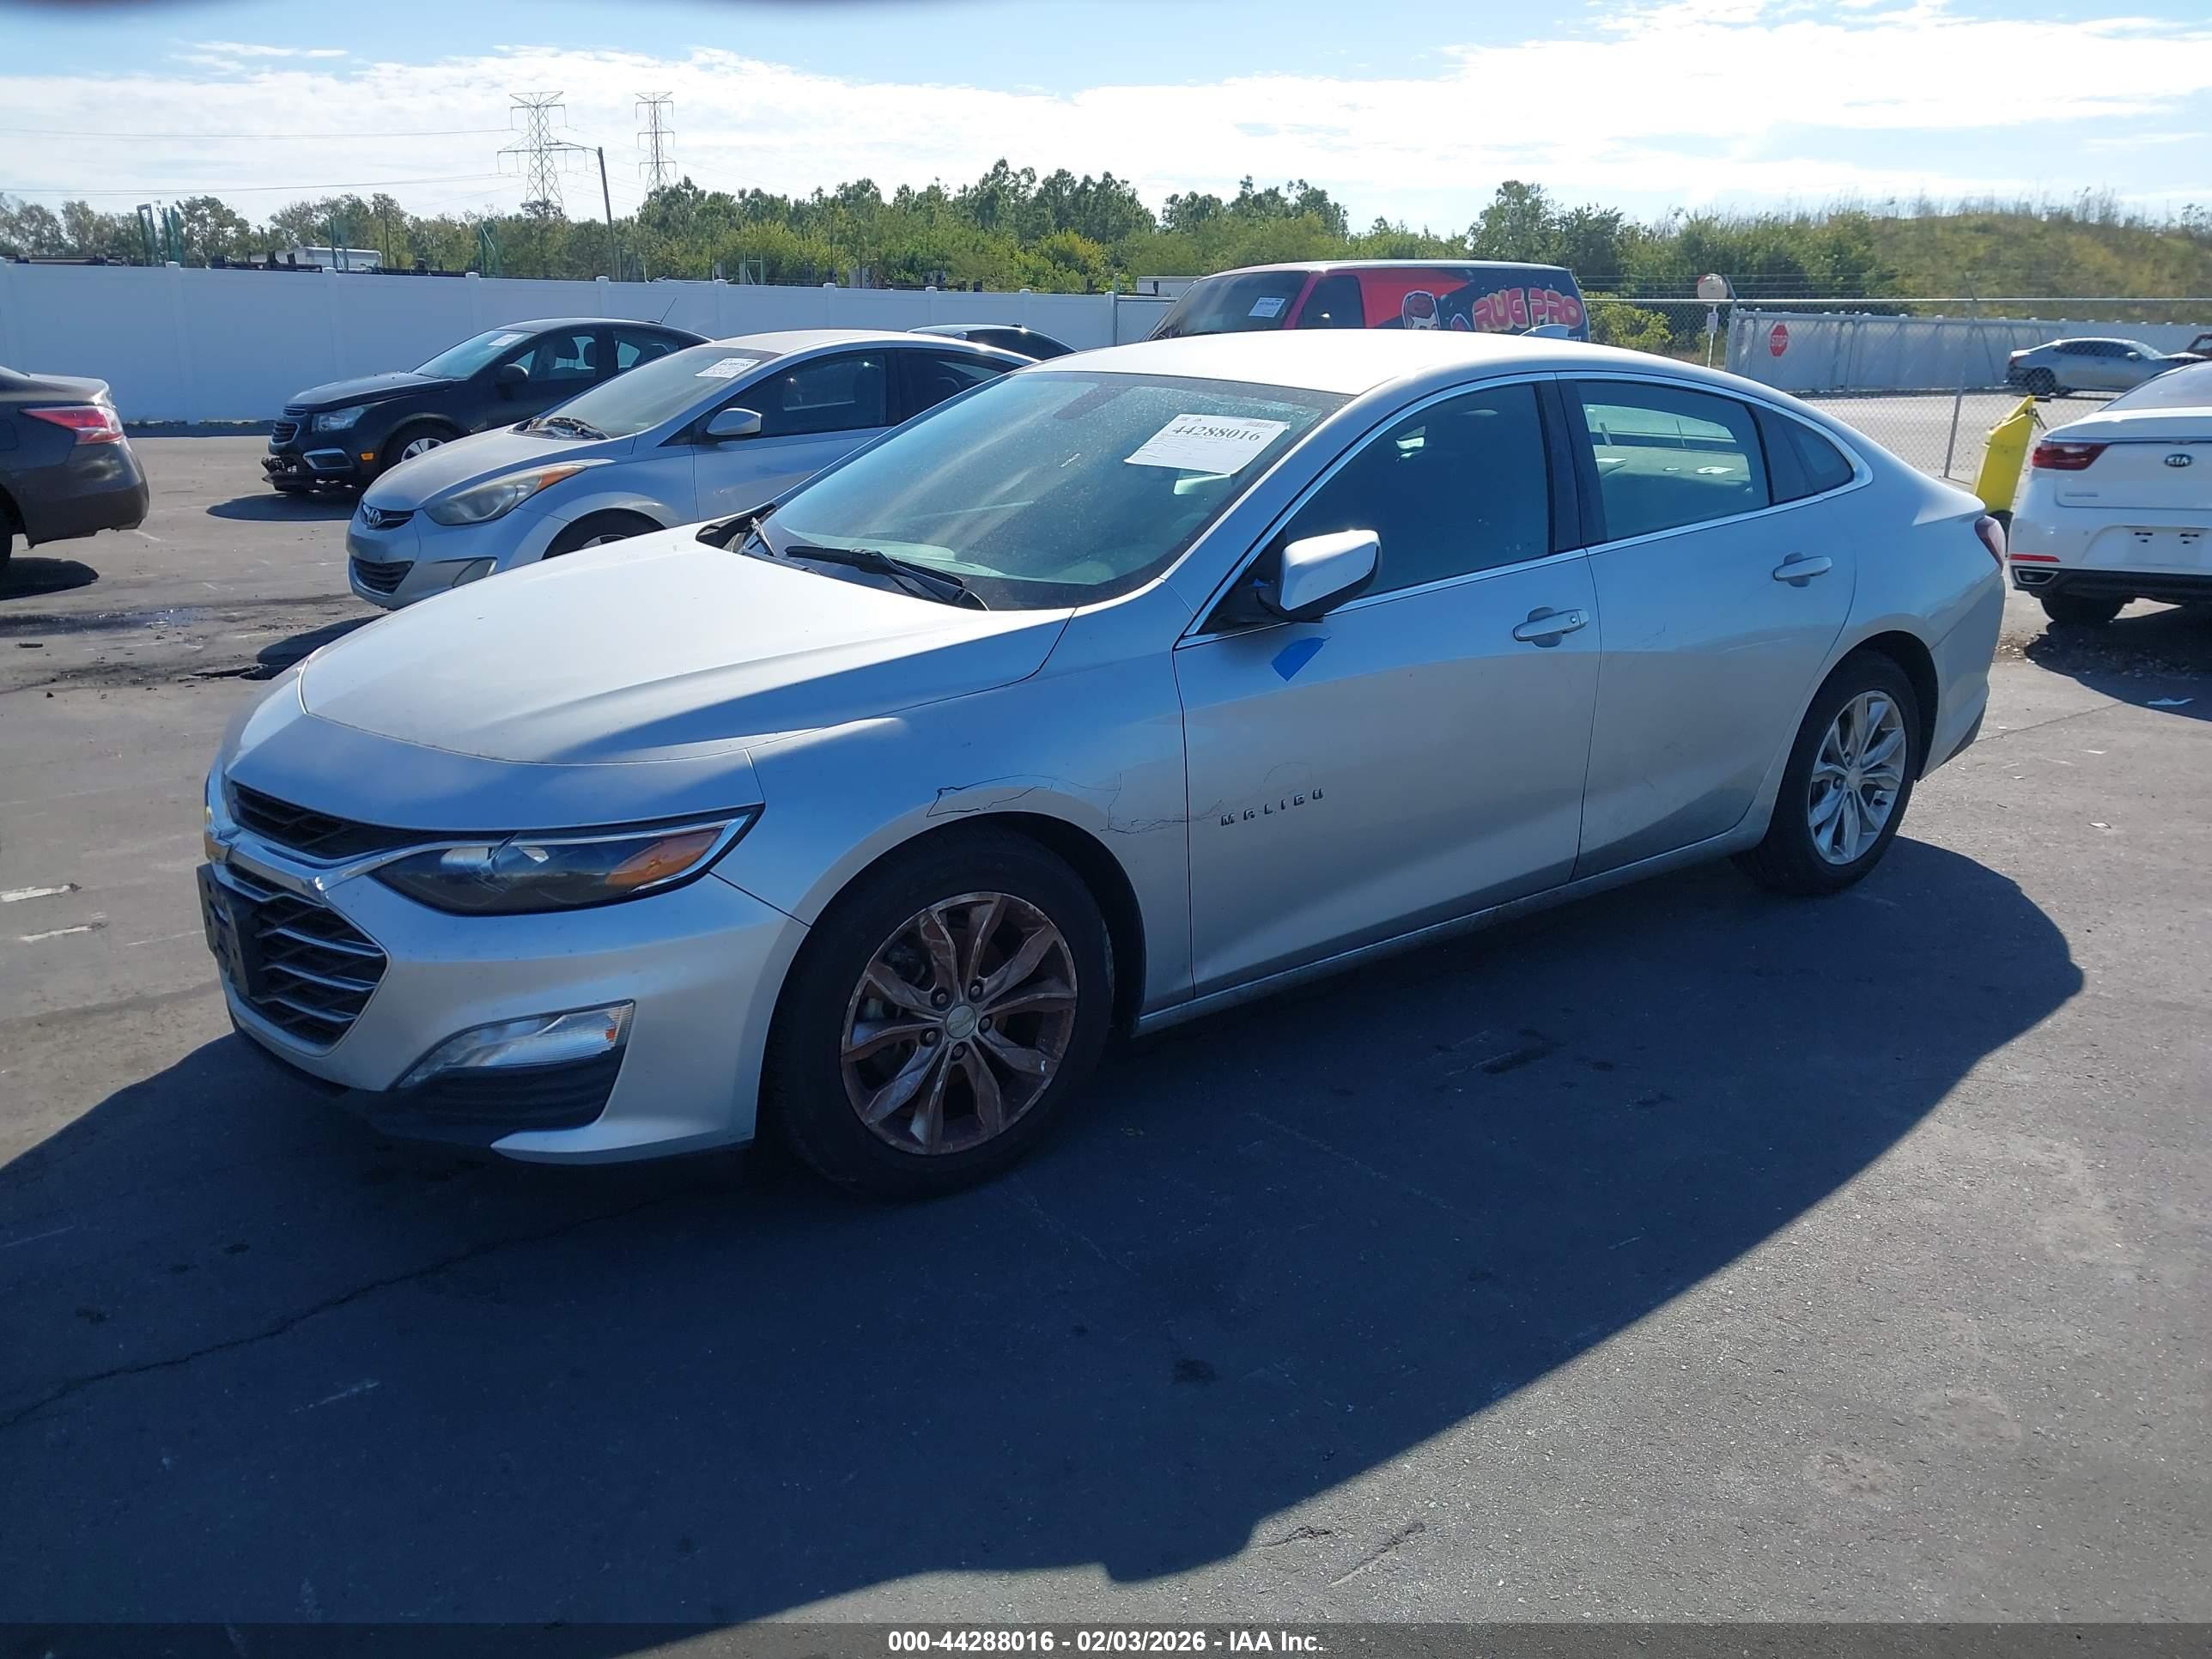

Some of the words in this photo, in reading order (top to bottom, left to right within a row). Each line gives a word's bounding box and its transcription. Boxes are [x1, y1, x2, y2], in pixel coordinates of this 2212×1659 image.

[1473, 288, 1528, 332] RUG
[1528, 288, 1583, 329] PRO
[1172, 424, 1265, 441] 44288016
[2166, 456, 2190, 467] KIA
[1220, 787, 1324, 826] MALIBU
